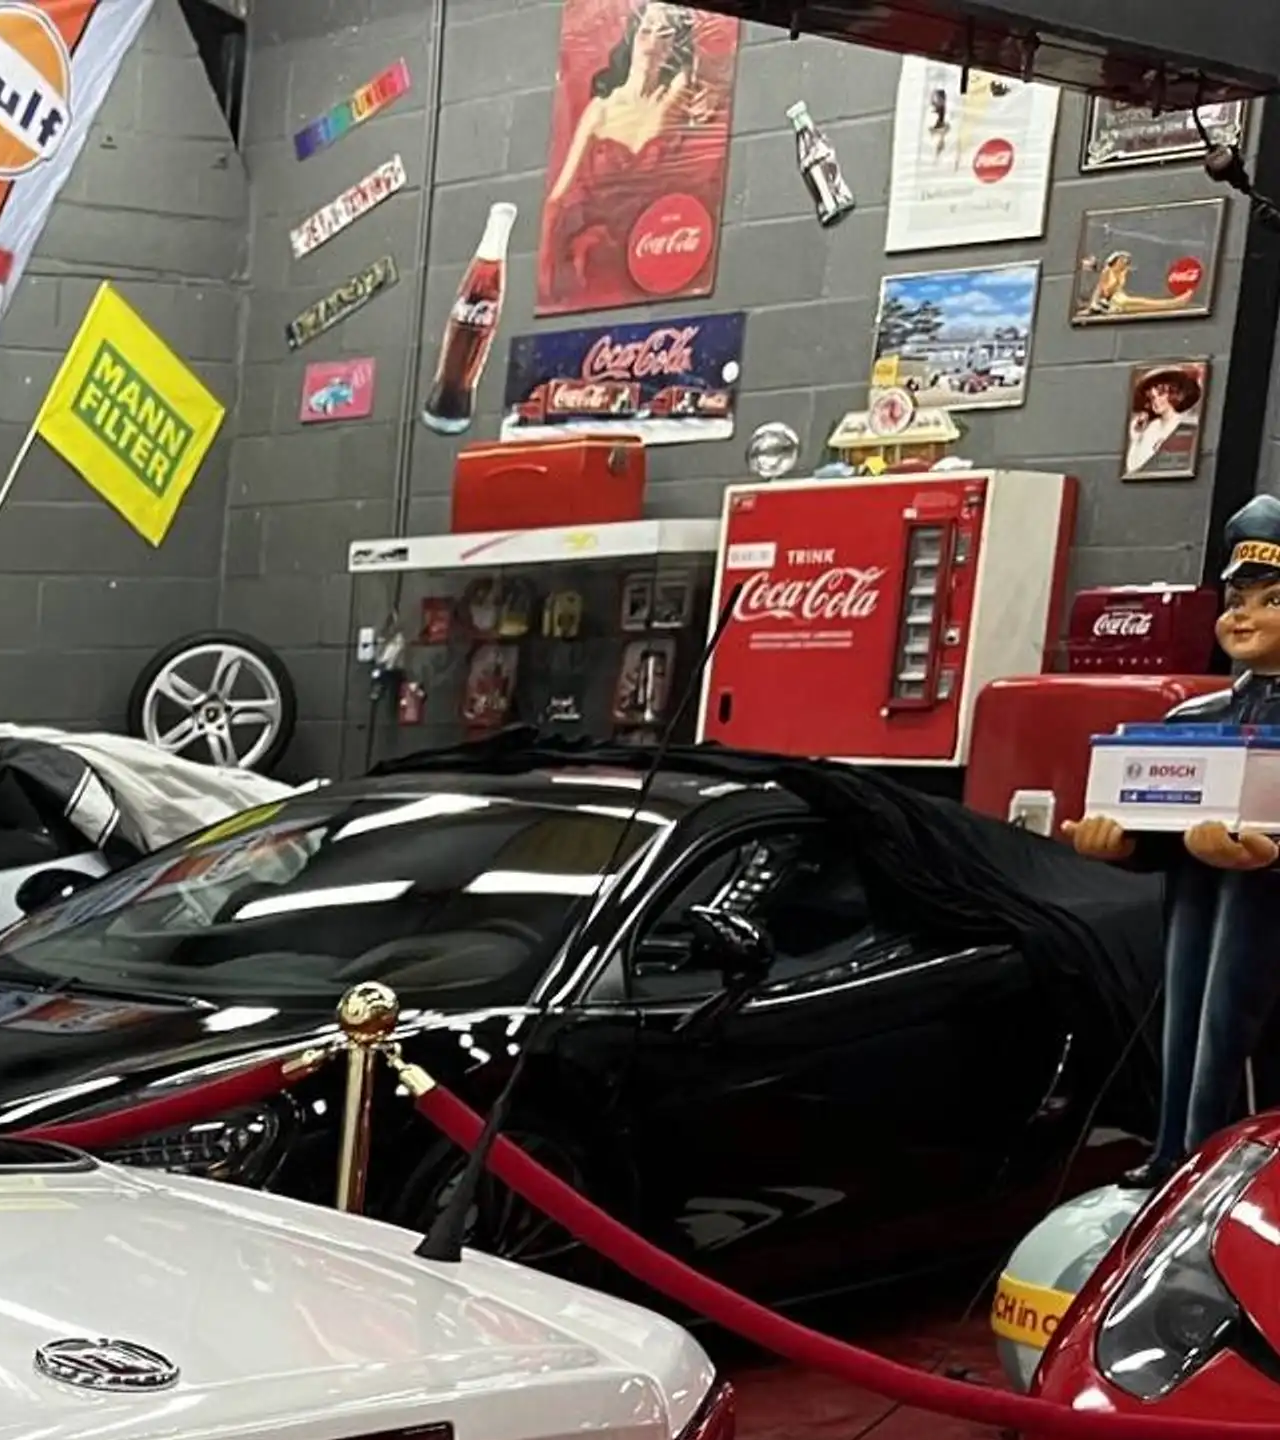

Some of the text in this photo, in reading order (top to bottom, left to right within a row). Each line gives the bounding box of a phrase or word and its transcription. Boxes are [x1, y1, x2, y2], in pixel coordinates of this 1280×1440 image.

[582, 325, 700, 382] Coca-Cola
[93, 351, 188, 457] MANN
[79, 381, 171, 488] FILTER
[787, 548, 836, 565] TRINK
[732, 566, 889, 622] Coca-Cola
[1093, 611, 1154, 637] Coca-Cola
[1149, 764, 1197, 778] BOSCH
